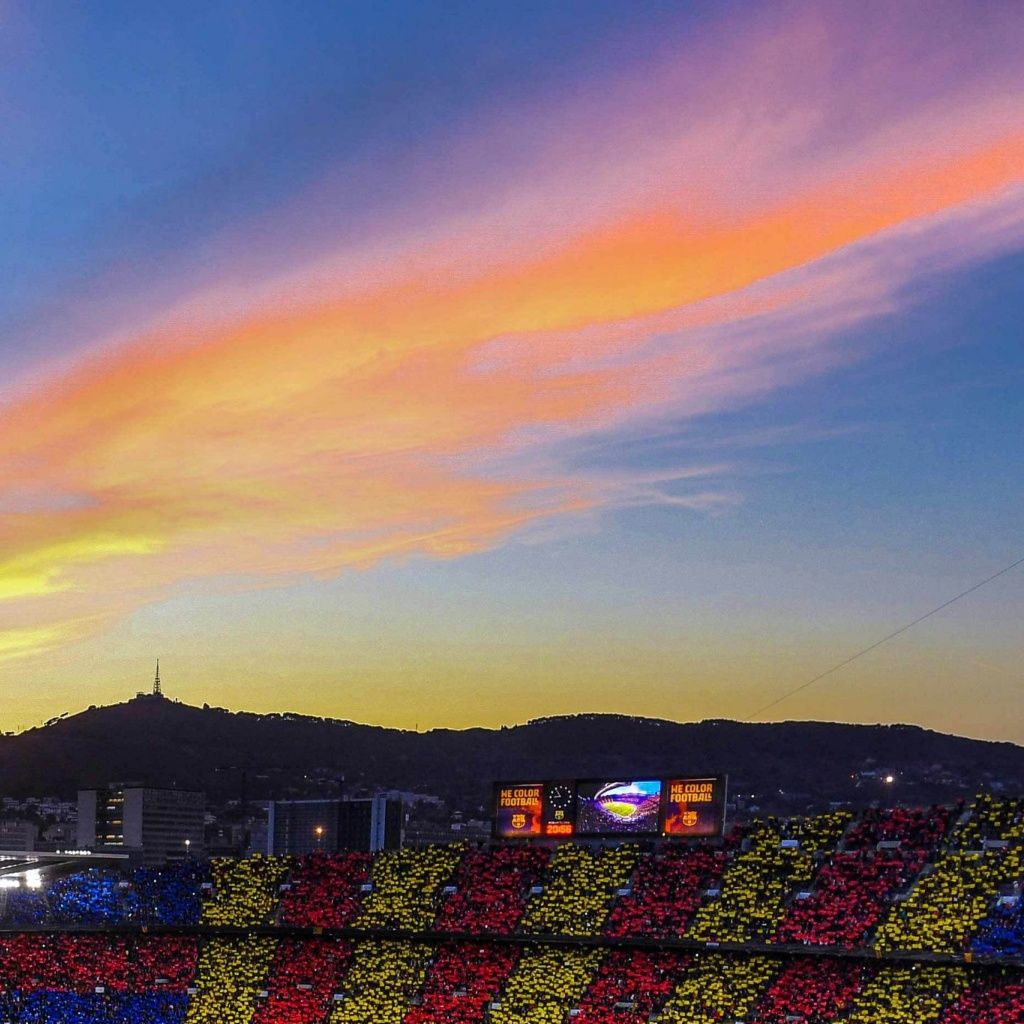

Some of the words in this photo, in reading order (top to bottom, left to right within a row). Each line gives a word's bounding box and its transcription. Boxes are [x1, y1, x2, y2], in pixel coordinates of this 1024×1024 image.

[501, 789, 513, 798] WE
[514, 788, 540, 798] COLOR
[671, 784, 684, 794] WE
[685, 783, 713, 793] COLOR
[500, 797, 539, 807] FOOTBALL
[670, 792, 713, 803] FOOTBALL
